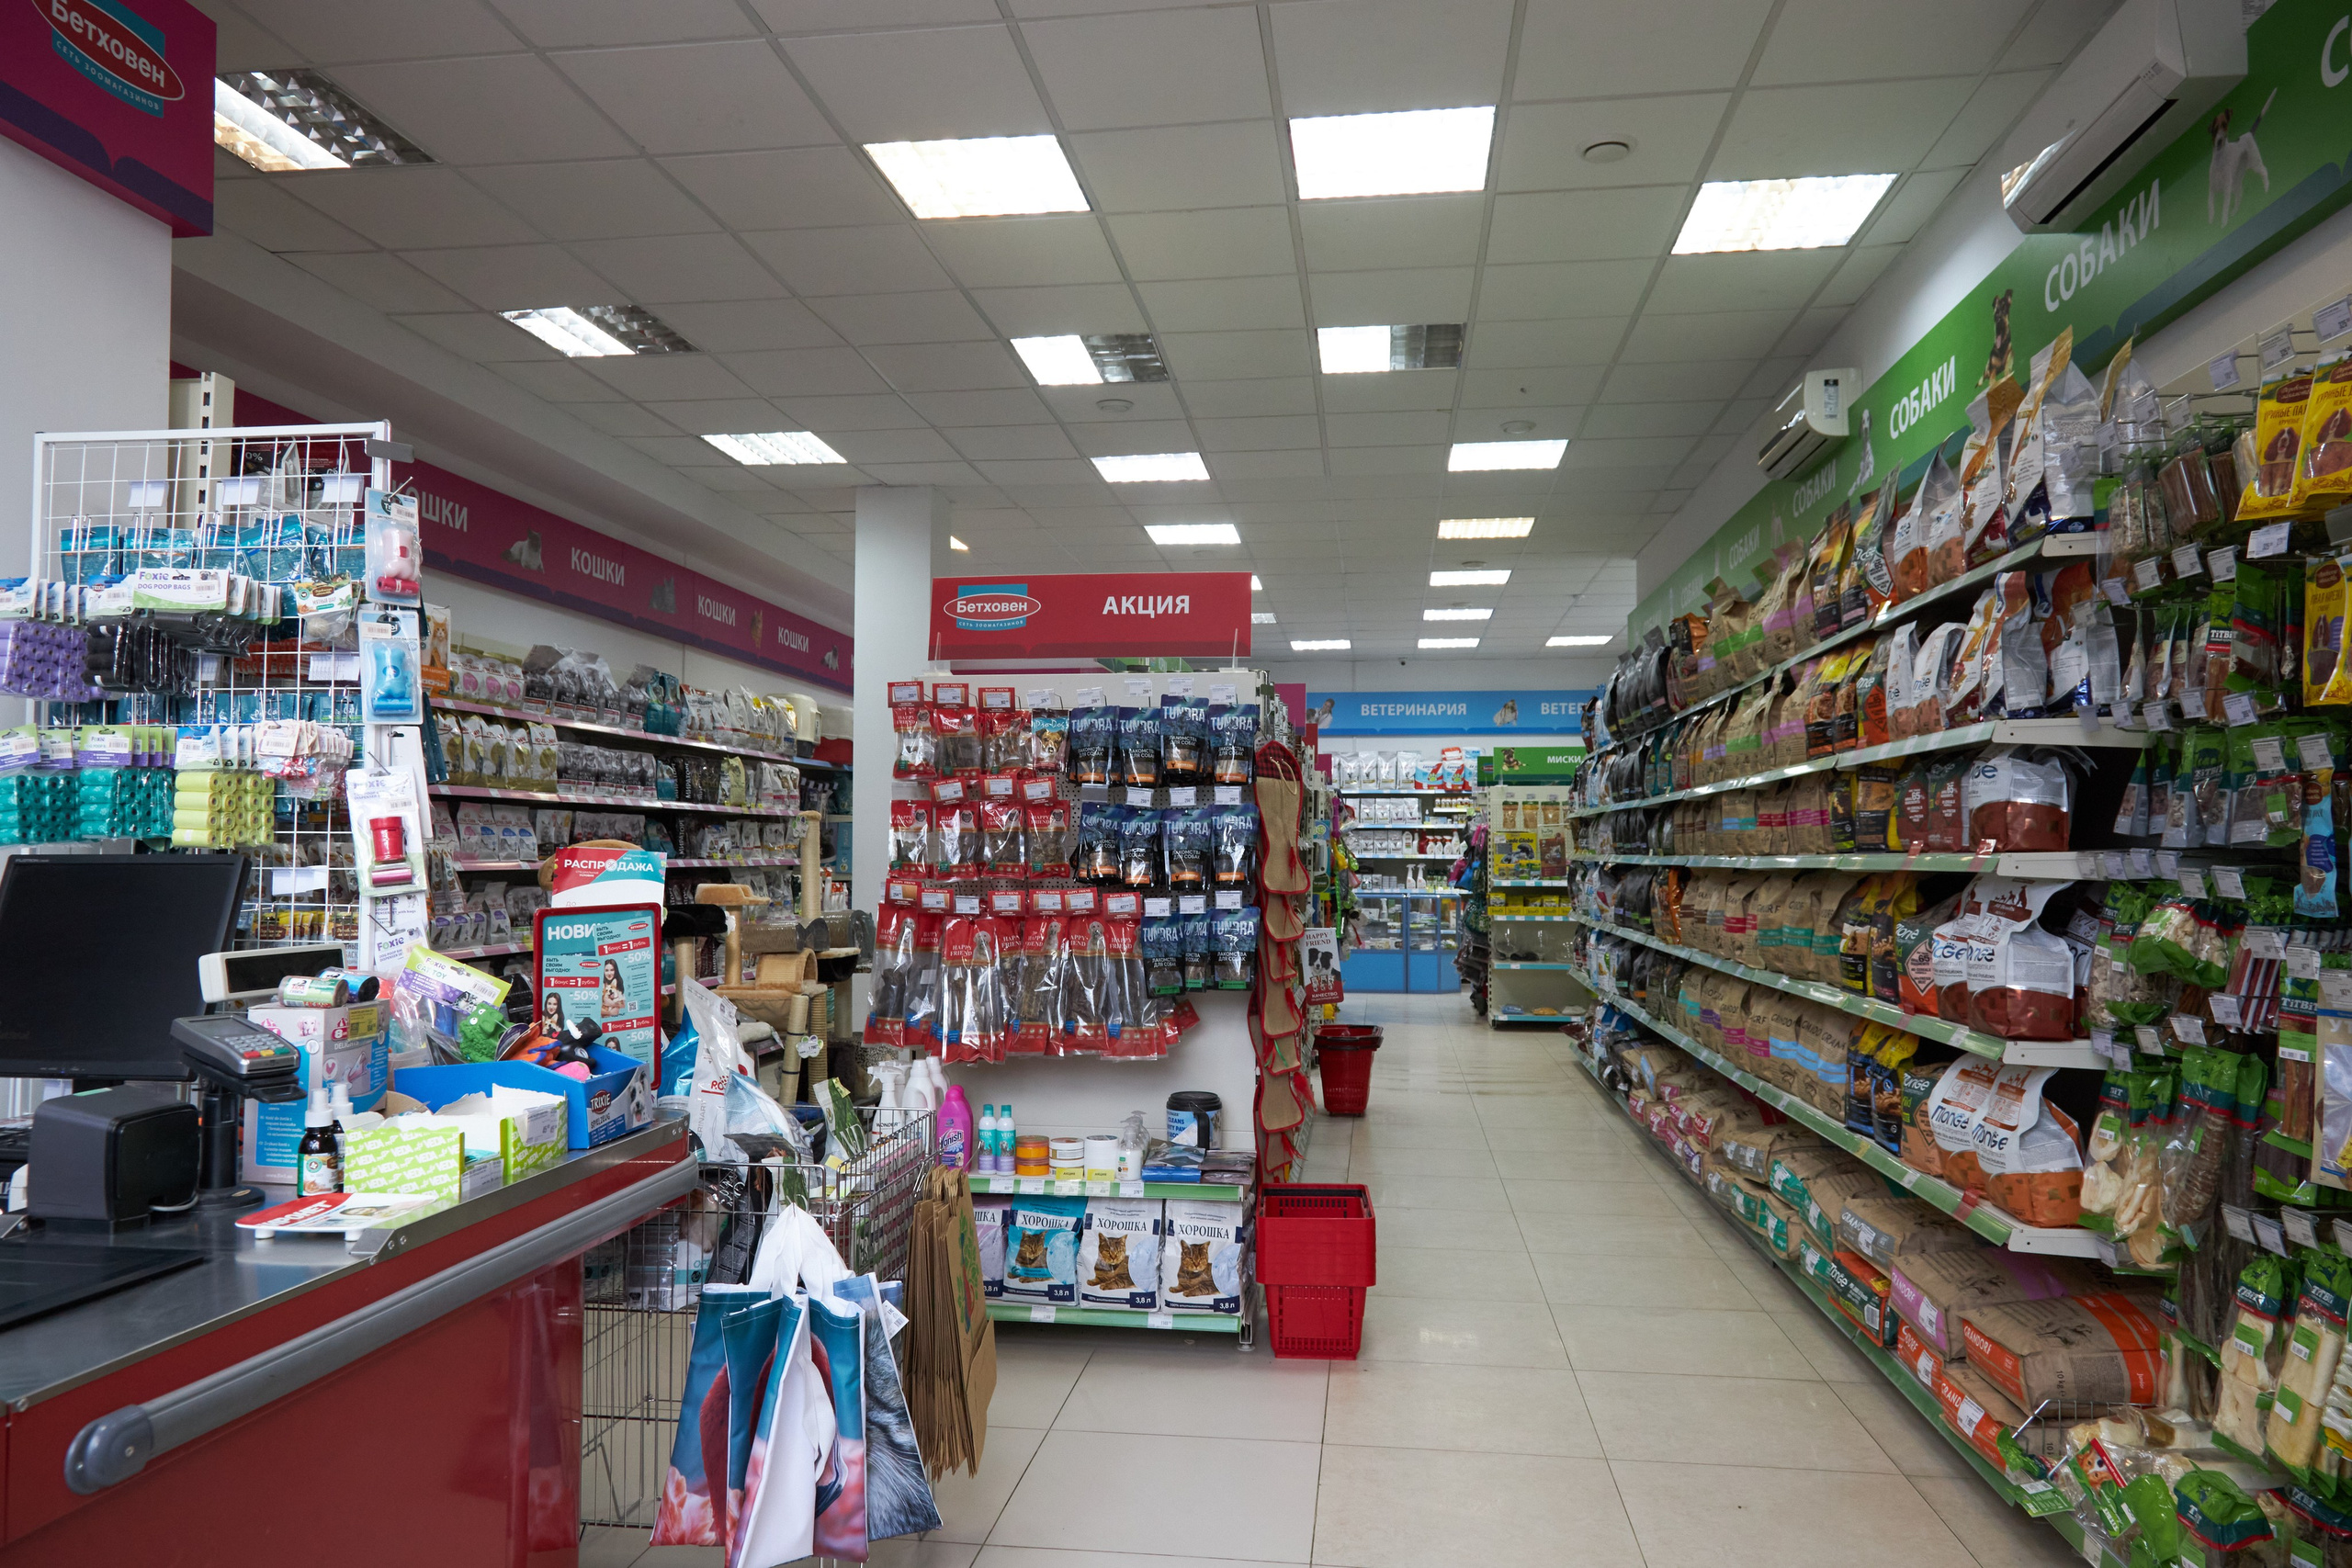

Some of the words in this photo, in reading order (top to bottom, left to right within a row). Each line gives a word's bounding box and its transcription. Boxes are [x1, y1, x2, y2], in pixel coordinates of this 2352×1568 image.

[51, 0, 164, 88] Бетховен
[56, 40, 81, 64] СЕТЬ
[84, 62, 160, 111] ЗООМАГАЗИНОВ
[2044, 177, 2159, 312] СОБАКИ
[1889, 355, 1956, 440] СОБАКИ
[1792, 459, 1837, 518] СОБАКИ
[1728, 524, 1760, 570] СОБАКИ
[139, 570, 169, 581] Foxie
[571, 547, 625, 587] КОШКИ
[698, 594, 736, 627] КОШКИ
[956, 600, 1028, 614] Бетховен
[1102, 595, 1191, 619] АКЦИЯ
[958, 620, 974, 628] СЕТЬ
[975, 619, 1024, 628] ЗООМАГАЗИНОВ
[777, 626, 809, 653] КОШКИ
[1162, 705, 1205, 723] TUNDRA
[1361, 703, 1467, 716] ВЕТЕРИНАРИЯ
[1071, 718, 1113, 733] TUNDRA
[1119, 719, 1160, 734] TUNDRA
[1211, 716, 1253, 731] TUNDRA
[1082, 814, 1118, 831] TUNDRA
[1121, 821, 1158, 836] TUNDRA
[1167, 820, 1209, 836] TUNDRA
[1213, 815, 1253, 830] TUNDRA
[1143, 926, 1179, 942] TUNDRA
[1211, 920, 1255, 936] TUNDRA
[1306, 931, 1329, 941] HAPPY
[377, 937, 404, 952] Foxie
[1306, 939, 1331, 947] FRIEND
[569, 990, 599, 1001] -50%
[590, 1092, 611, 1111] TRIXIE
[590, 1112, 611, 1130] SPIELZEUG
[1931, 1104, 1970, 1130] Monge
[940, 1129, 963, 1147] Vanish
[1971, 1122, 2009, 1151] Monge
[1097, 1217, 1148, 1232] ХОРОШКА
[1178, 1224, 1230, 1240] ХОРОШКА
[1891, 1270, 1917, 1303] GRANDORF
[1963, 1325, 1993, 1357] GRANDORF
